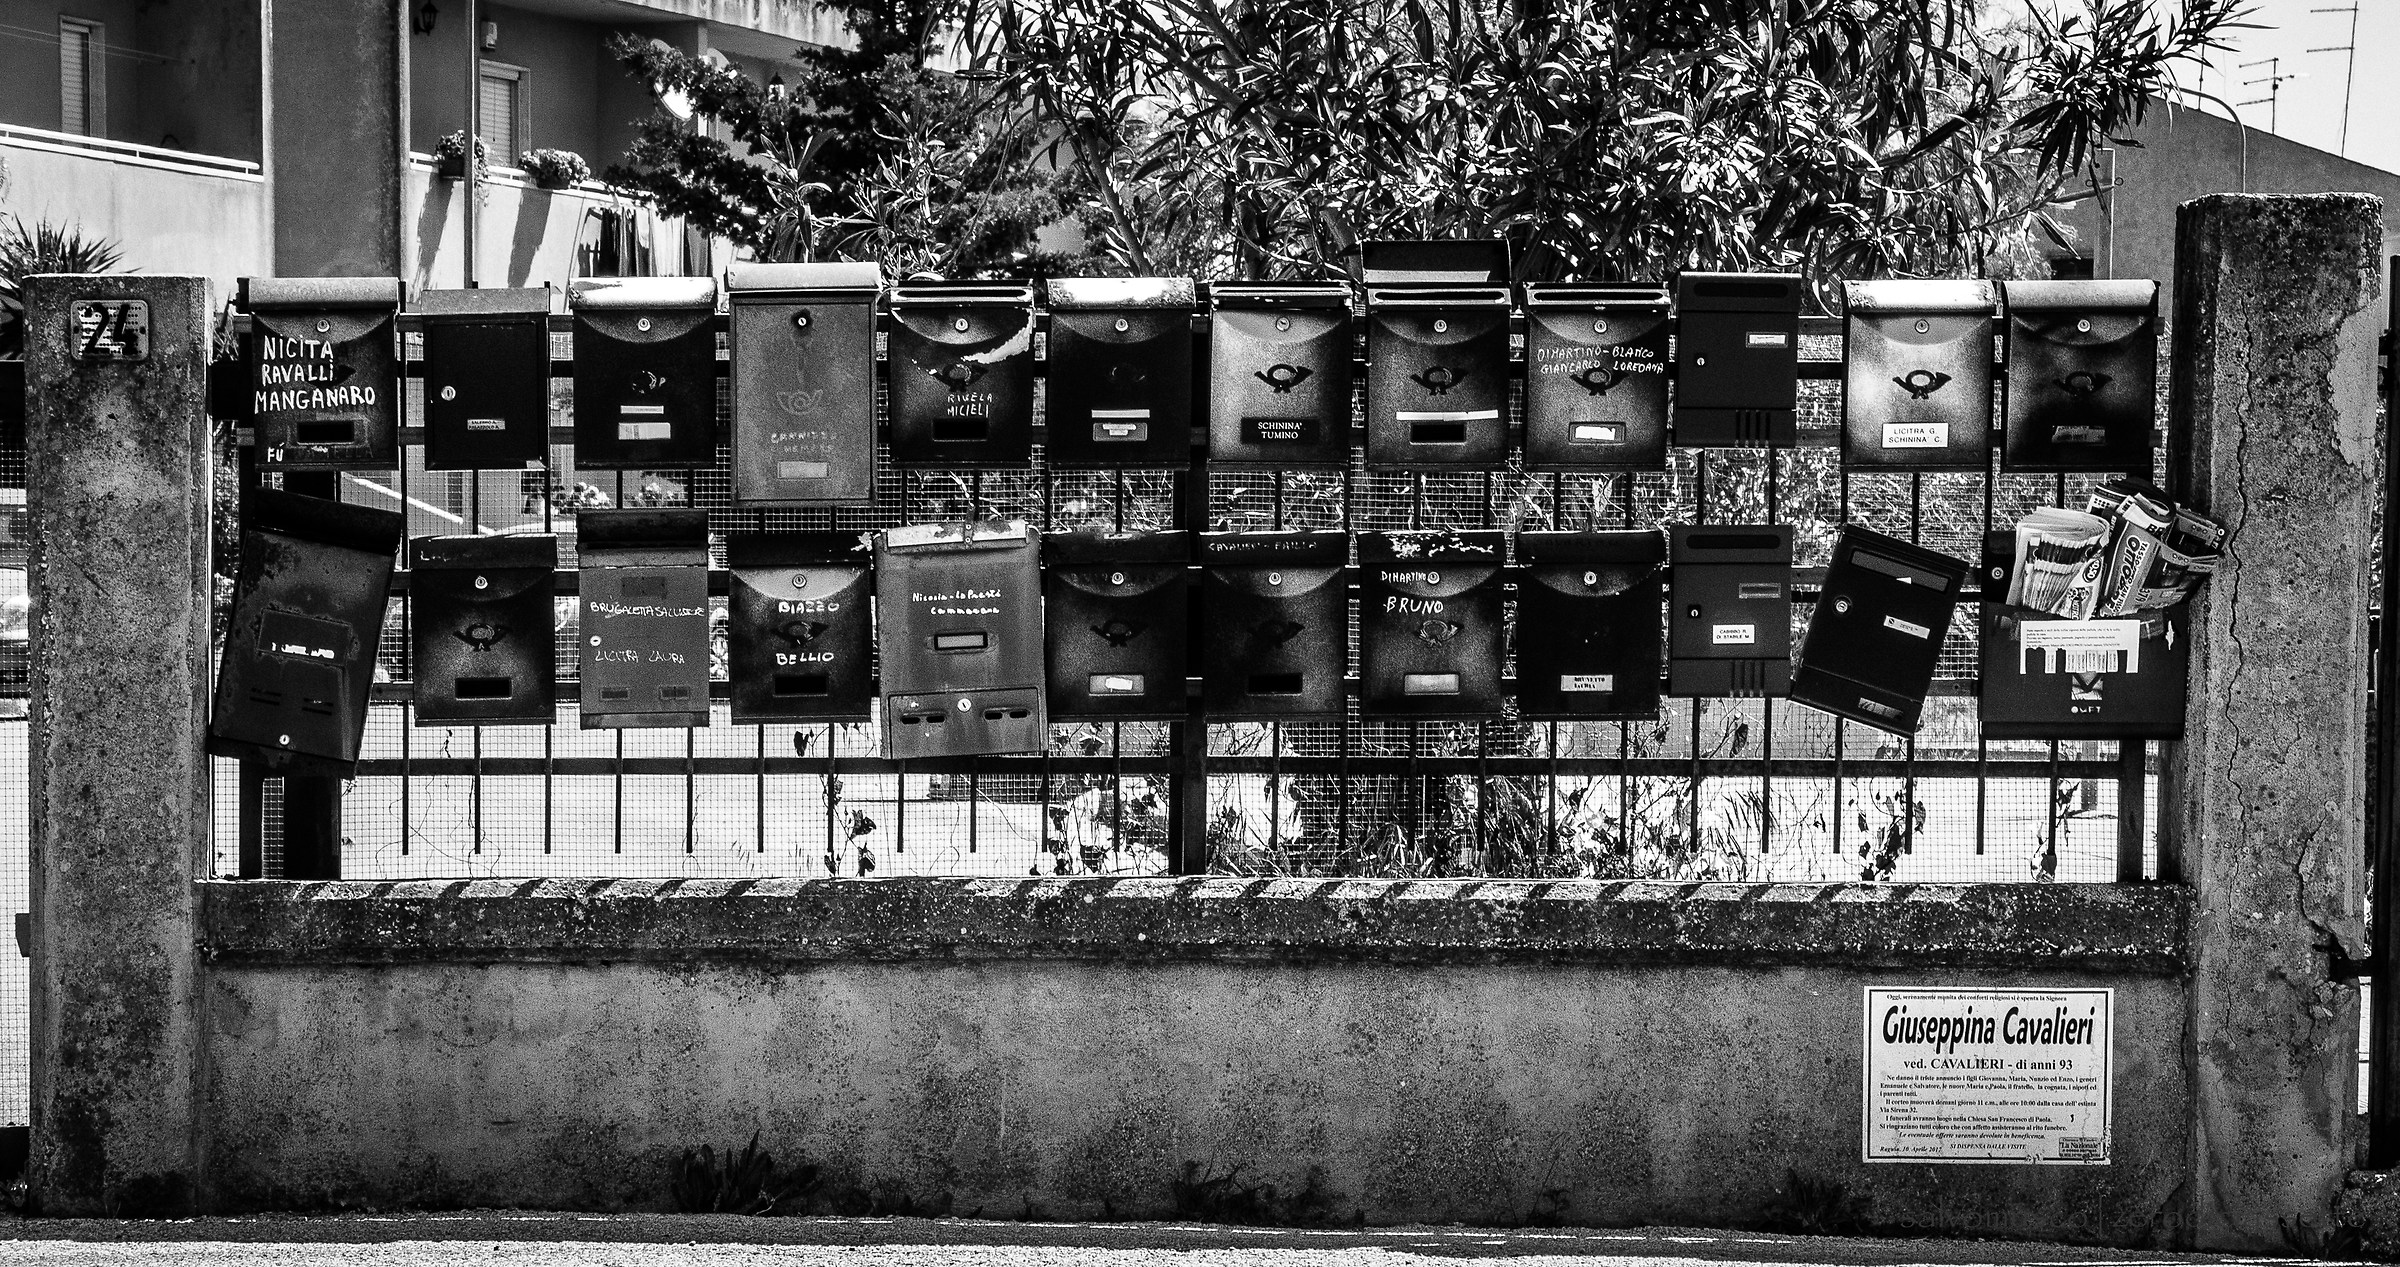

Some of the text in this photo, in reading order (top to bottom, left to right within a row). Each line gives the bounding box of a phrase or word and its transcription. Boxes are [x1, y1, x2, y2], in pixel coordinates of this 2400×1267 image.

[80, 302, 139, 356] 24
[263, 334, 334, 361] NICITA
[1612, 345, 1654, 359] BLANCO
[261, 359, 334, 387] RAVALLI
[1540, 359, 1664, 375] GIANCARLO LOREDANA
[254, 385, 376, 415] MANGANARO
[1261, 431, 1299, 440] TUMINO
[1893, 427, 1938, 435] LICITRA G.
[778, 601, 840, 615] BIAZZO
[648, 650, 686, 665] LAURA
[775, 652, 835, 666] BELLIO
[1883, 1005, 2095, 1055] Giuseppina Cavalieri
[1904, 1059, 1927, 1070] ved.
[1931, 1059, 2004, 1070] CAVALIERI
[2016, 1059, 2027, 1070] di
[2030, 1059, 2056, 1070] anni
[2059, 1059, 2073, 1071] 93
[1936, 1114, 1952, 1122] luogo
[1886, 1122, 1918, 1130] ringraziano
